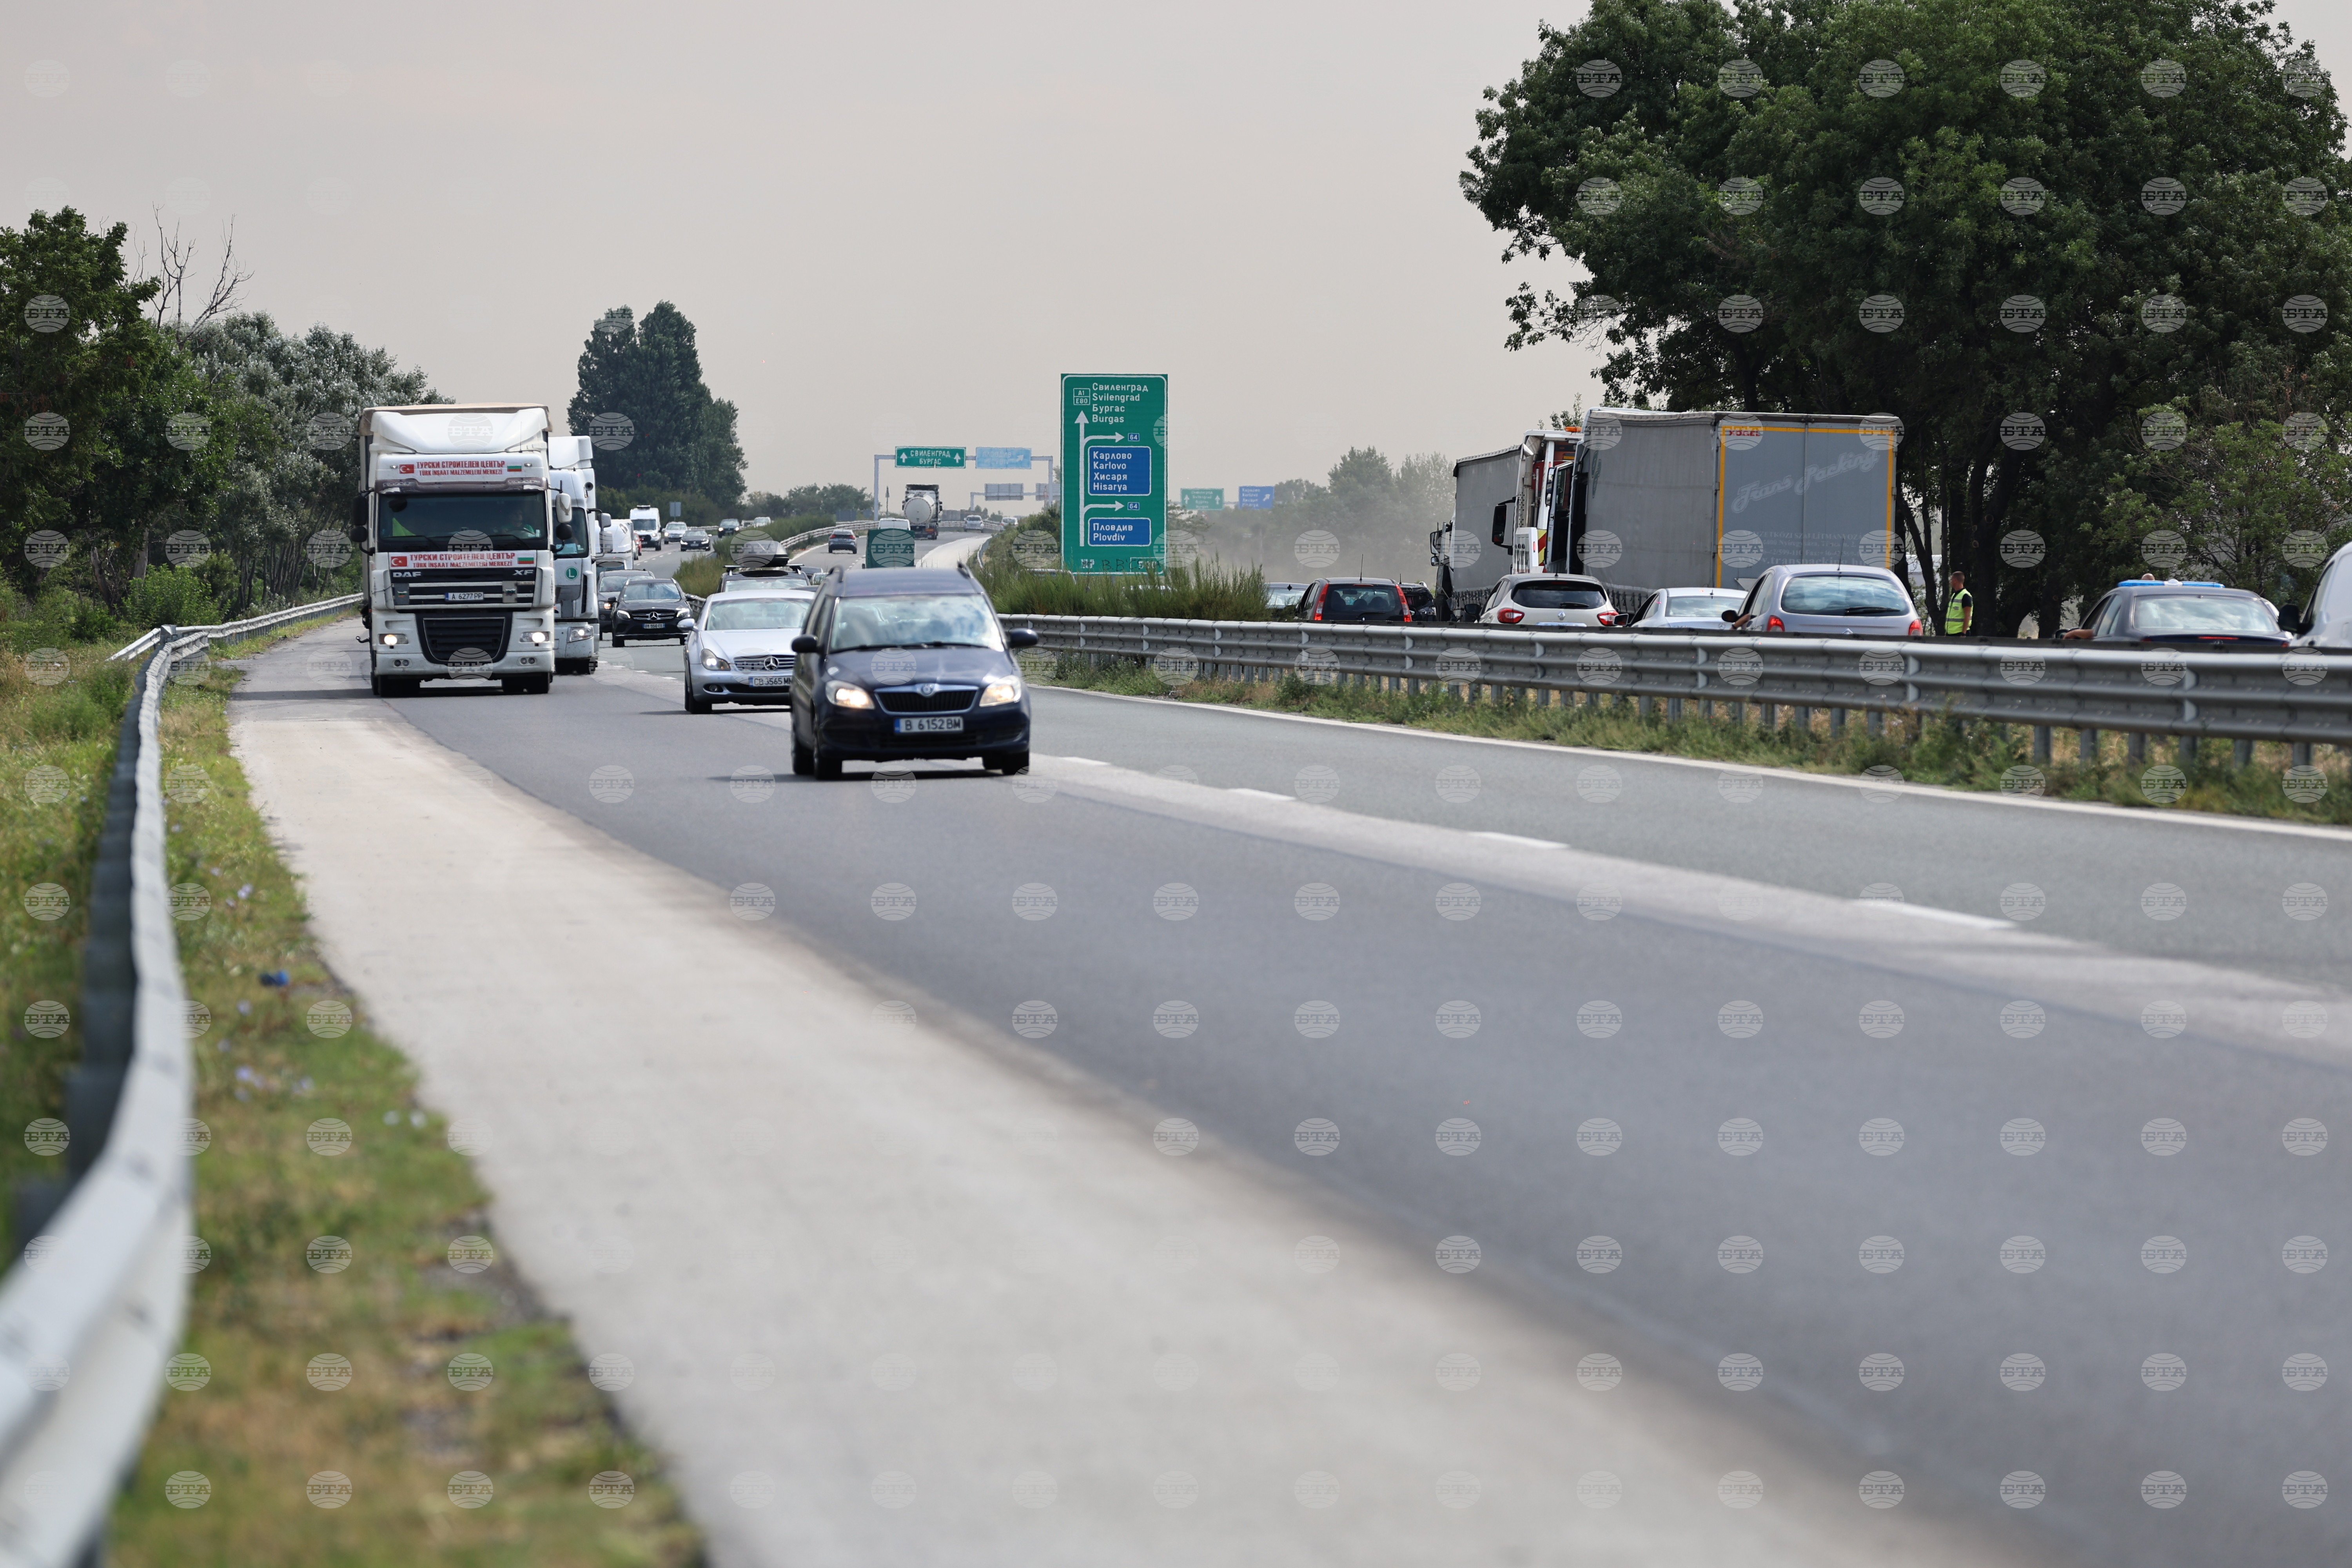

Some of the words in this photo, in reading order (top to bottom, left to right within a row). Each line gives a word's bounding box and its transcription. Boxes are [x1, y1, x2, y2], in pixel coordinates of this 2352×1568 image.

[1092, 382, 1149, 393] Свиленград
[1092, 393, 1140, 403] Svilengrad
[1092, 404, 1125, 414] Бургас
[1092, 414, 1124, 425] Burgas
[1093, 451, 1132, 461] Карлово
[1093, 461, 1127, 469] Karlovo
[1093, 472, 1127, 482] Хисаря
[1731, 475, 1794, 514] Trans
[1794, 446, 1880, 495] Packing
[1093, 482, 1127, 492] Hisarya
[1093, 523, 1133, 532] Пловдив
[1093, 533, 1125, 541] Plovdiv
[568, 569, 575, 577] L
[905, 719, 912, 731] B
[918, 718, 944, 730] 6152
[946, 718, 960, 729] BM
